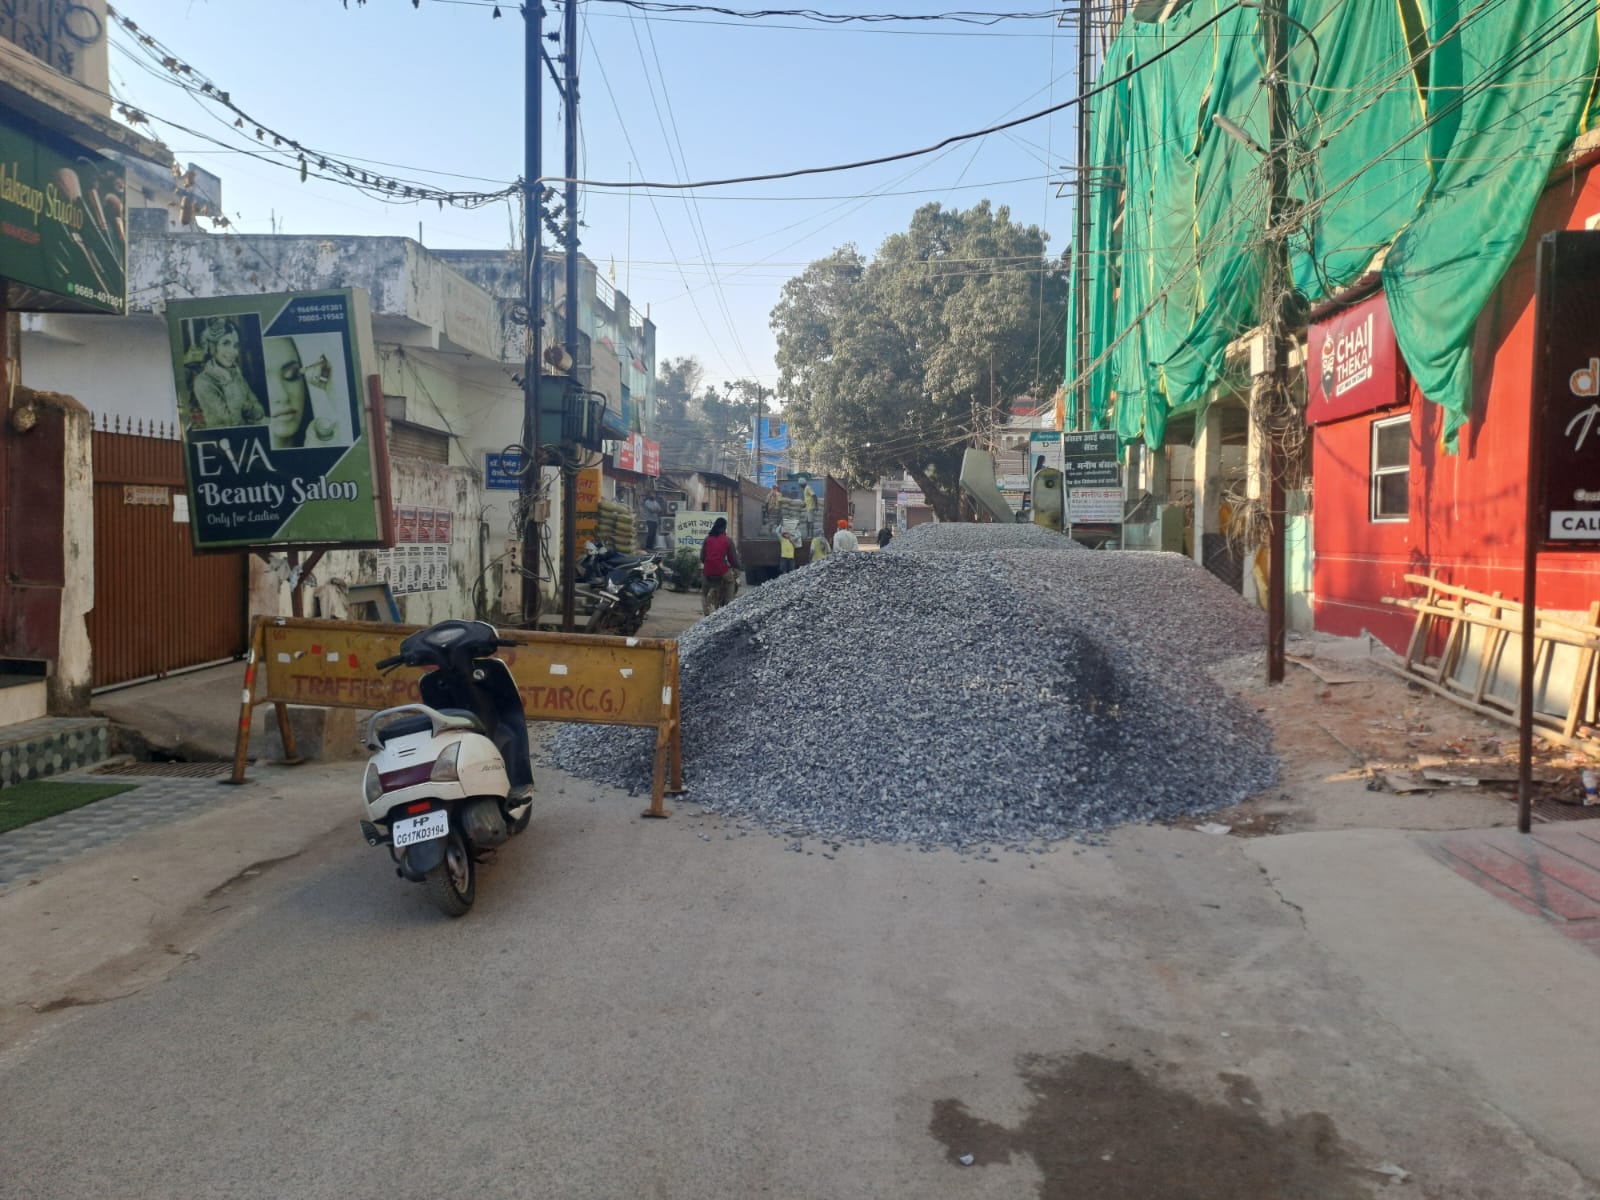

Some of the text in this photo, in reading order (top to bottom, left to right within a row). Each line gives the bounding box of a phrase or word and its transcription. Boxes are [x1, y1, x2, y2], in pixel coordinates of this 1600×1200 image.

[46, 183, 83, 230] Studio
[1337, 321, 1368, 363] CHAI
[1336, 349, 1368, 382] THEKA
[192, 437, 279, 477] EVA
[198, 481, 286, 508] Beauty
[291, 476, 359, 505] Salon
[207, 509, 280, 528] Only for Ladies
[291, 674, 385, 700] TRAFFIC
